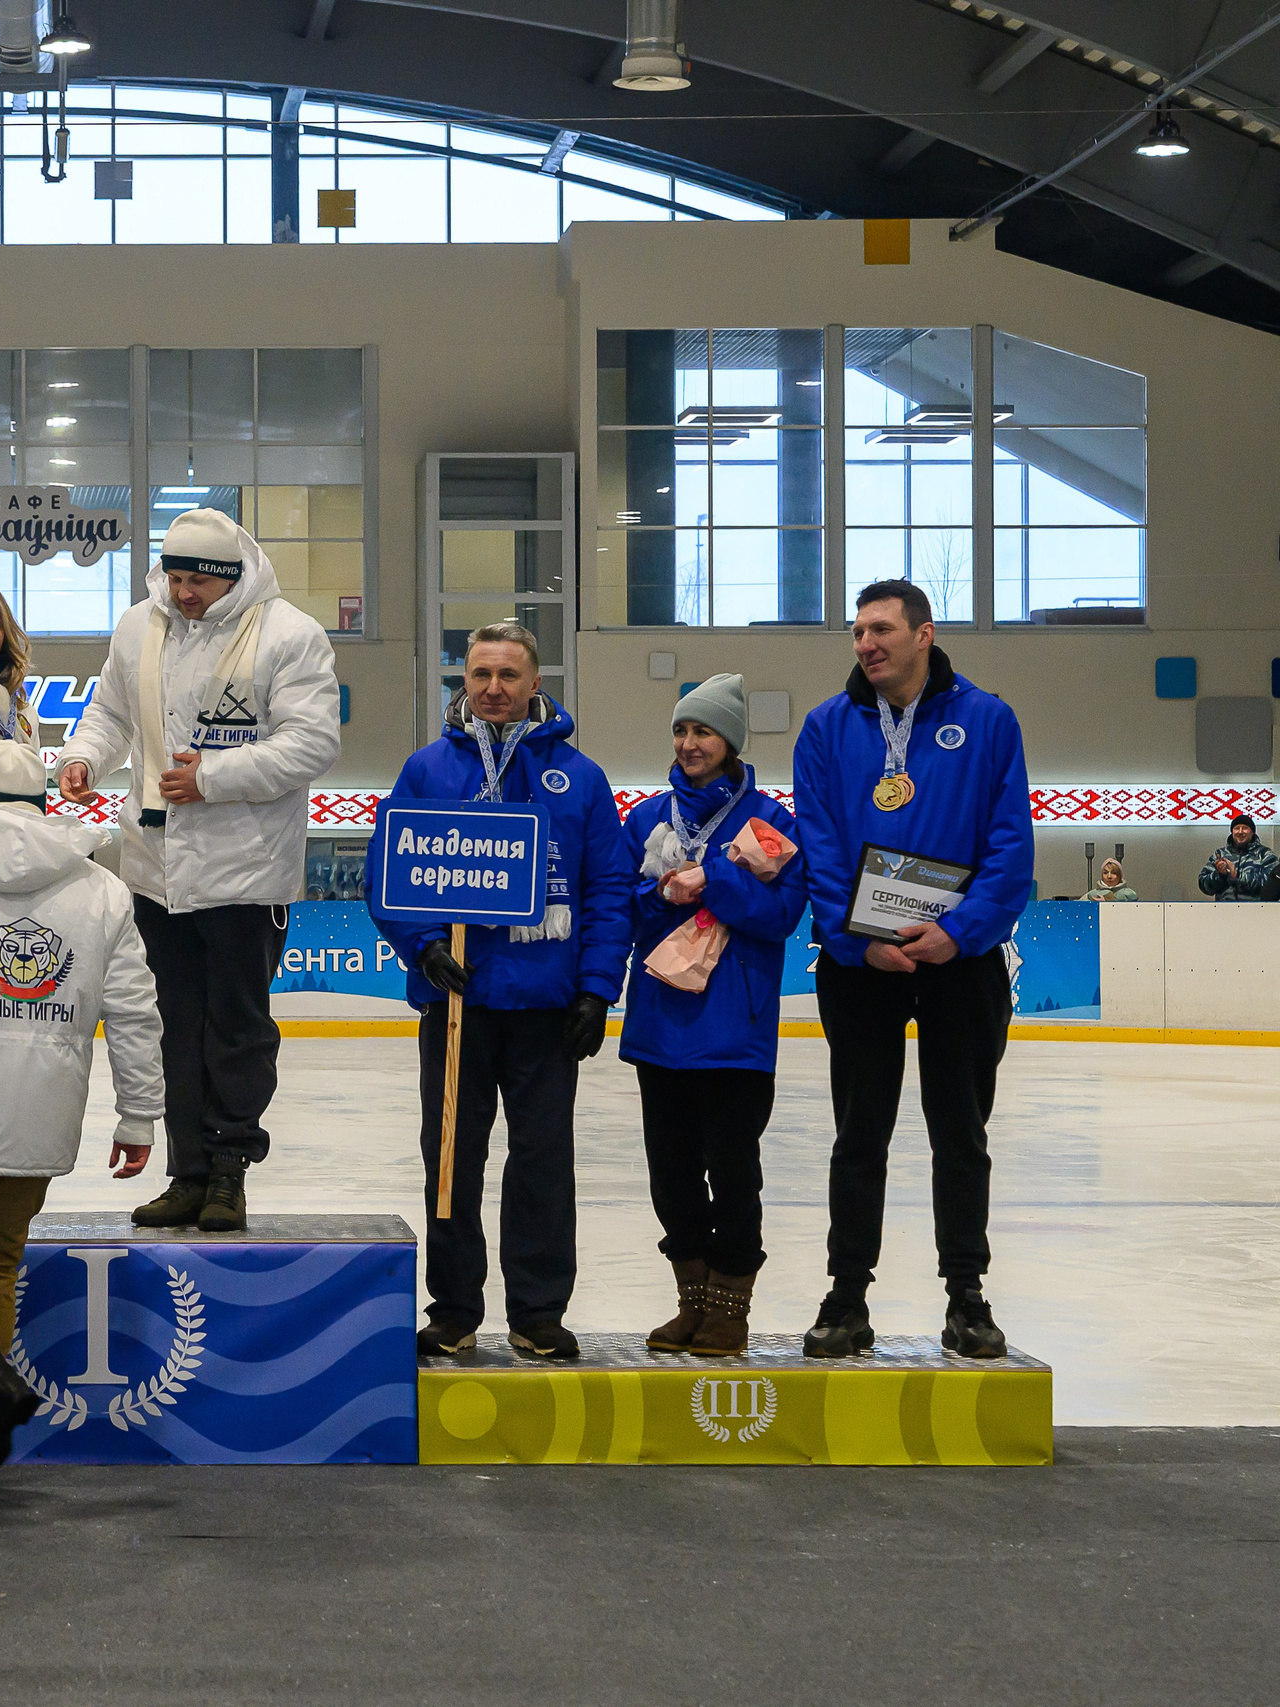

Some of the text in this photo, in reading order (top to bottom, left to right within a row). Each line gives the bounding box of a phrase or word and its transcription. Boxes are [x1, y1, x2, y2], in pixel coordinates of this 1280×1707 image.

[198, 562, 239, 575] БЕЛАРУСЬ
[223, 728, 259, 742] ТИГРЫ
[397, 827, 525, 860] Академия
[410, 865, 509, 895] сервиса
[871, 889, 948, 916] СЕРТИФИКАТ
[276, 947, 365, 979] ента
[26, 1000, 75, 1023] ТИГРЫ
[705, 1380, 763, 1418] III
